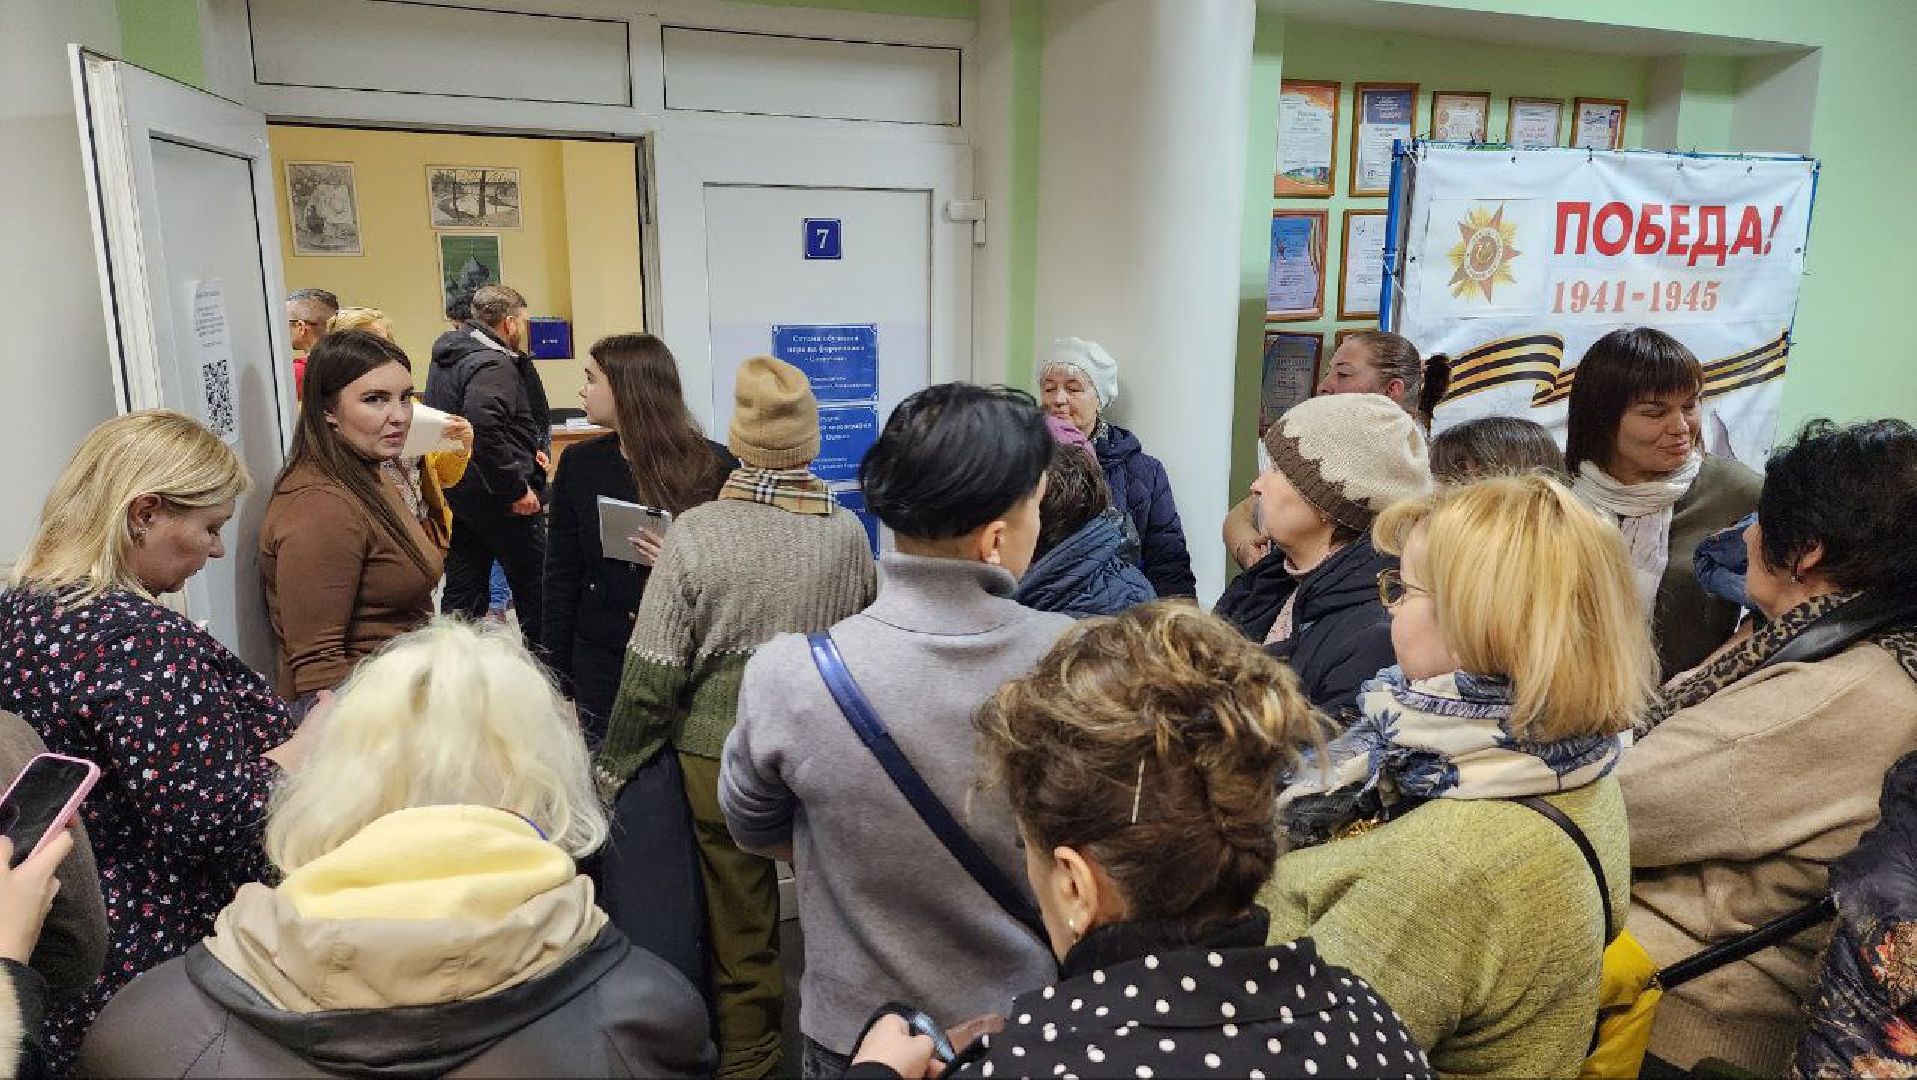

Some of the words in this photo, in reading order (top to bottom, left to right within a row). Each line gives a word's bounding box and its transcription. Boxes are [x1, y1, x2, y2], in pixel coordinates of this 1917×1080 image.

[816, 228, 829, 249] 7
[1554, 201, 1784, 266] ПОБЕДА!
[1551, 280, 1721, 314] 1941-1945
